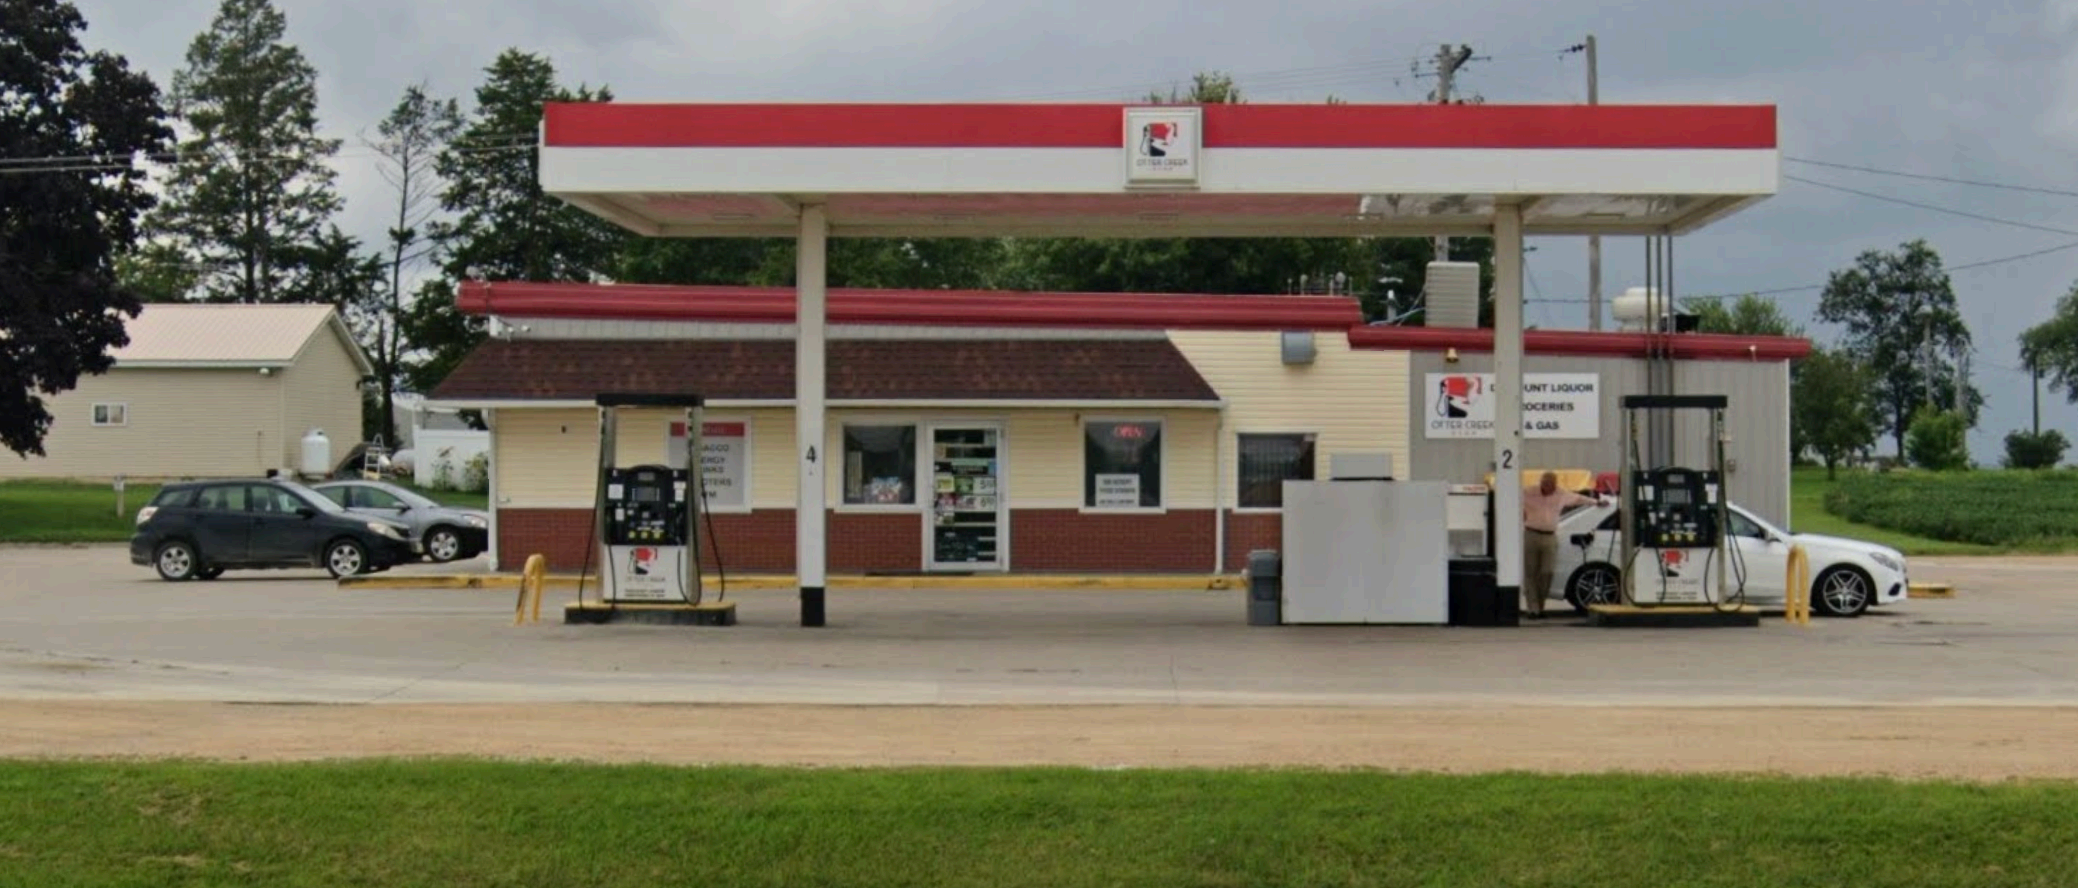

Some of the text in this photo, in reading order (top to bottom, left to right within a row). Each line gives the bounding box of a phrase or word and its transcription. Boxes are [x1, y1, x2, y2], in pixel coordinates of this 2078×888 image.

[1490, 383, 1594, 393] DUNT LIQUOR
[1522, 402, 1575, 411] OCERIES
[1525, 421, 1560, 430] & GAS
[1113, 424, 1146, 438] OPEN
[806, 445, 816, 463] 4
[1502, 448, 1513, 470] 2
[702, 478, 732, 487] OTERS
